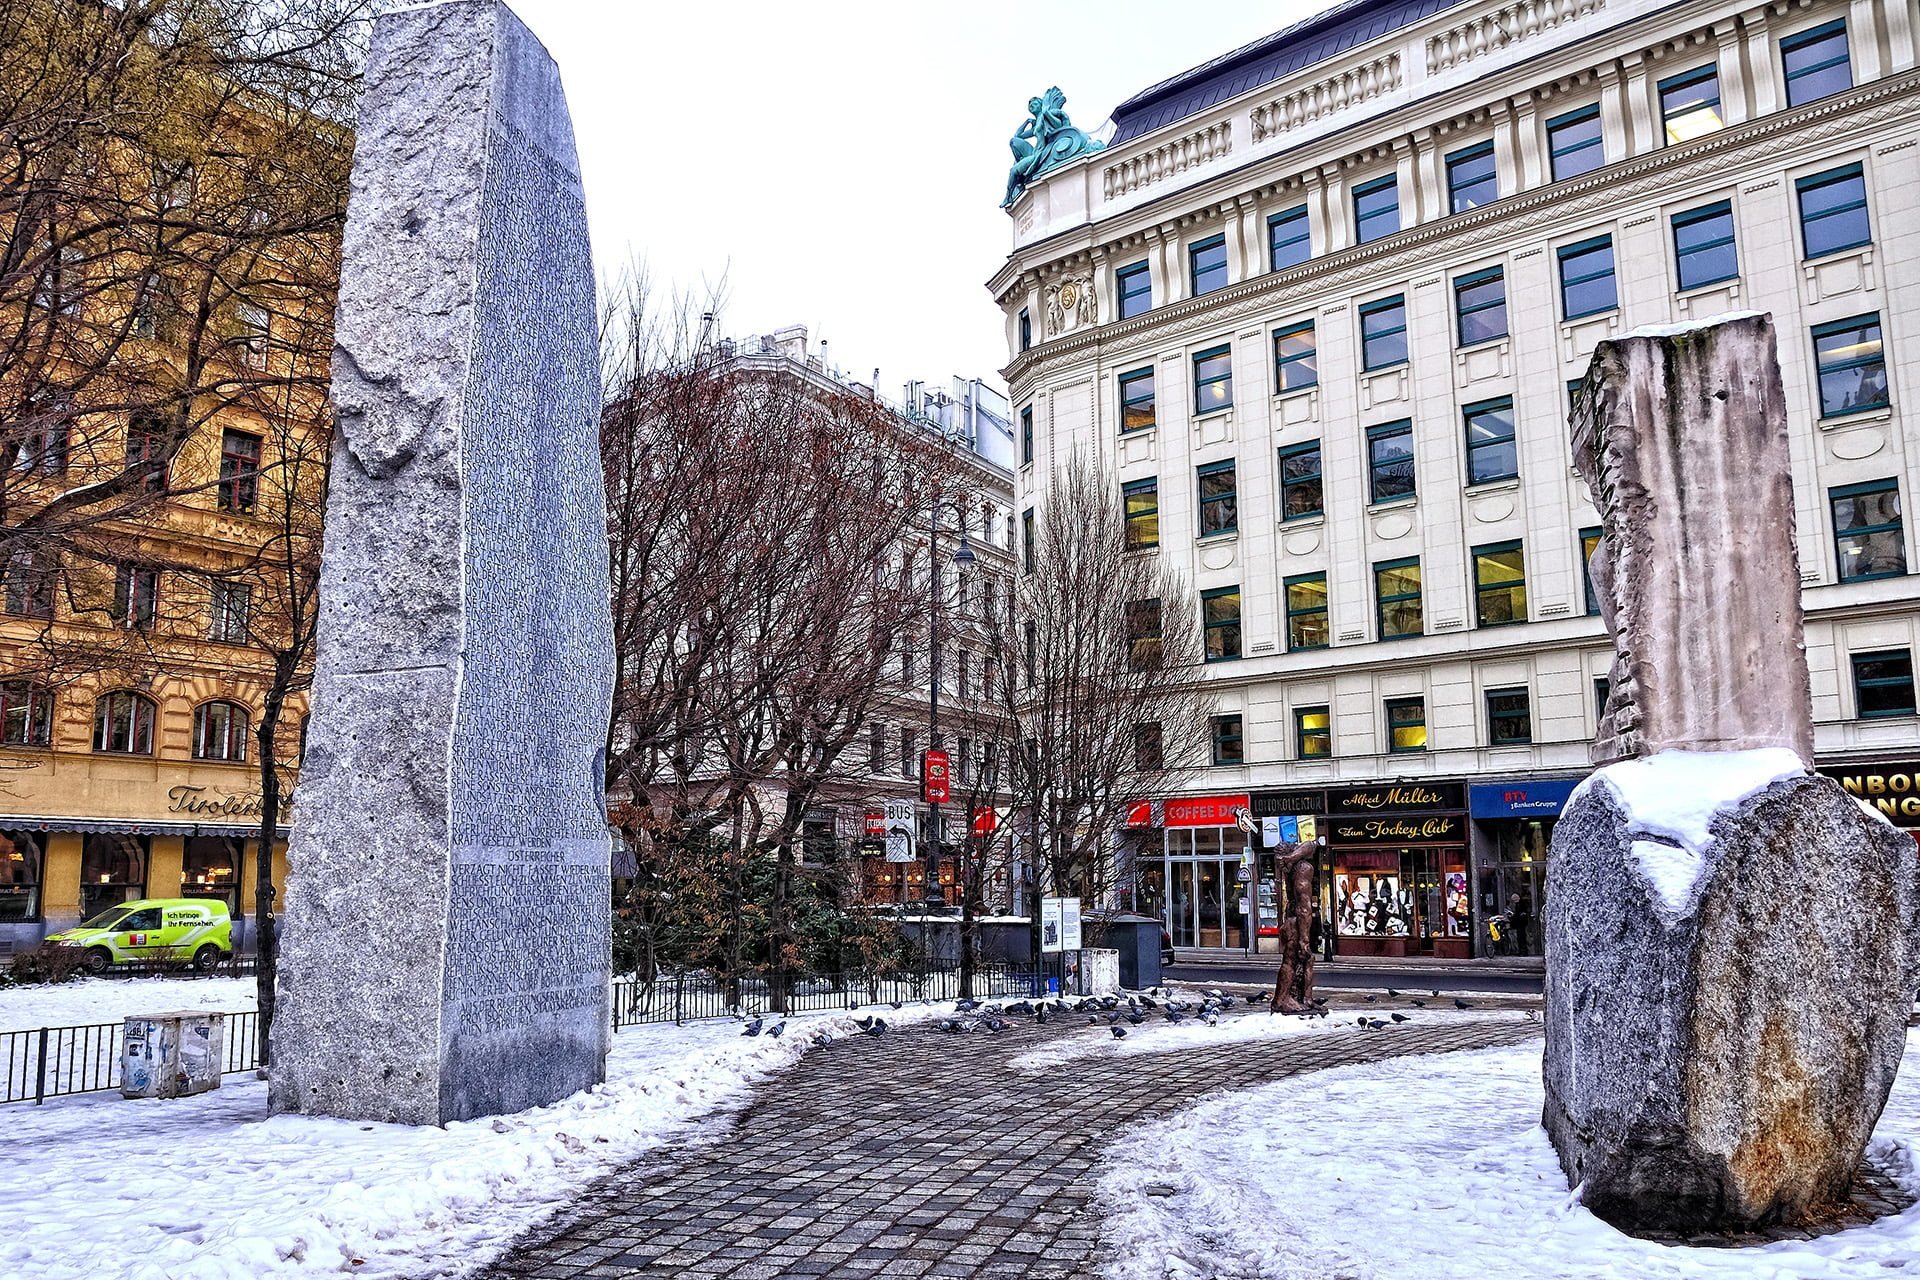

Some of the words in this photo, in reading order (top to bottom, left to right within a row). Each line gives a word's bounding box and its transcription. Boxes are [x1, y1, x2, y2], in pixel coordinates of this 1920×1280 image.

[1343, 793, 1380, 806] Alfred
[1367, 788, 1442, 808] Müller
[1504, 791, 1527, 802] BTV
[888, 805, 911, 820] BUS
[1168, 805, 1215, 819] COFFEE
[1338, 827, 1365, 837] Zum
[178, 912, 200, 920] bringe
